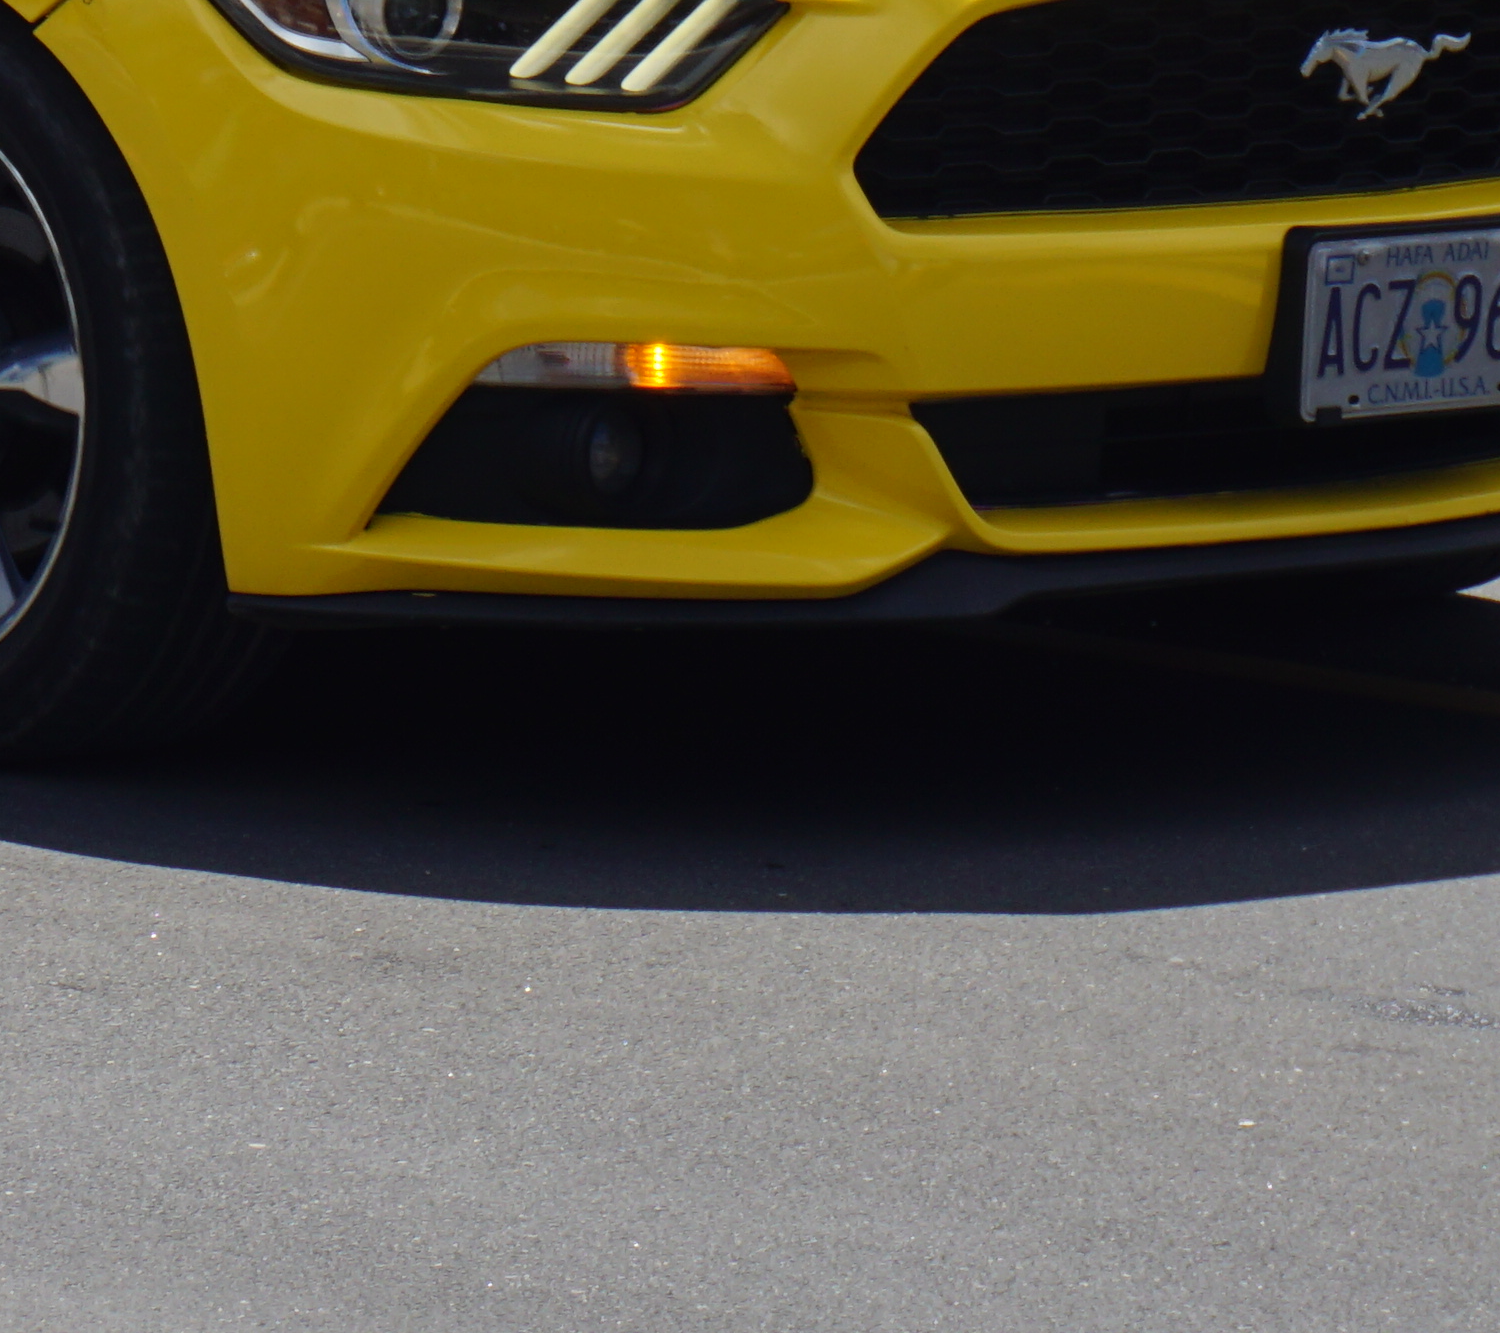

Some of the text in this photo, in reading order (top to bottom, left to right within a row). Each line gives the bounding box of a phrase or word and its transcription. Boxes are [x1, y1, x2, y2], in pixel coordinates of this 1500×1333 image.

[1386, 241, 1490, 266] HAFA ADAI
[1317, 278, 1416, 379] ACZ
